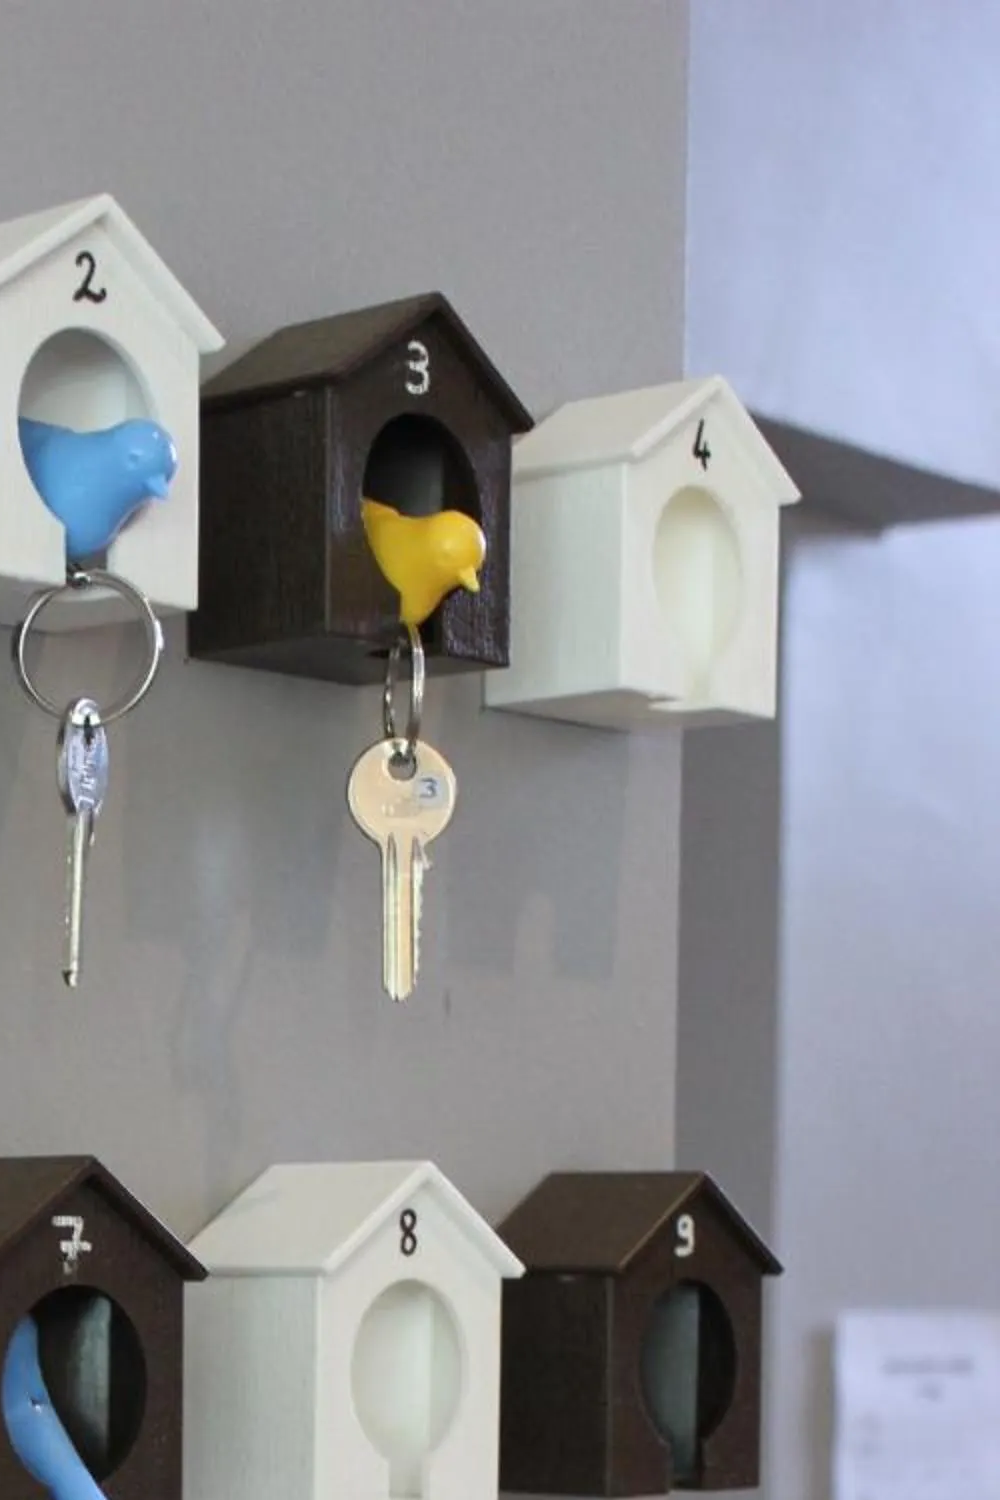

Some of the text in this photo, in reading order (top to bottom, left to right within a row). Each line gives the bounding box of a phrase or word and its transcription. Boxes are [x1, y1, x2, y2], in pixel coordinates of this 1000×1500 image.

[72, 251, 107, 304] 2
[405, 340, 431, 395] 3
[692, 418, 712, 472] 4
[418, 777, 437, 798] 3
[51, 1215, 93, 1274] 7
[399, 1208, 418, 1257] 8
[674, 1213, 695, 1258] 9
